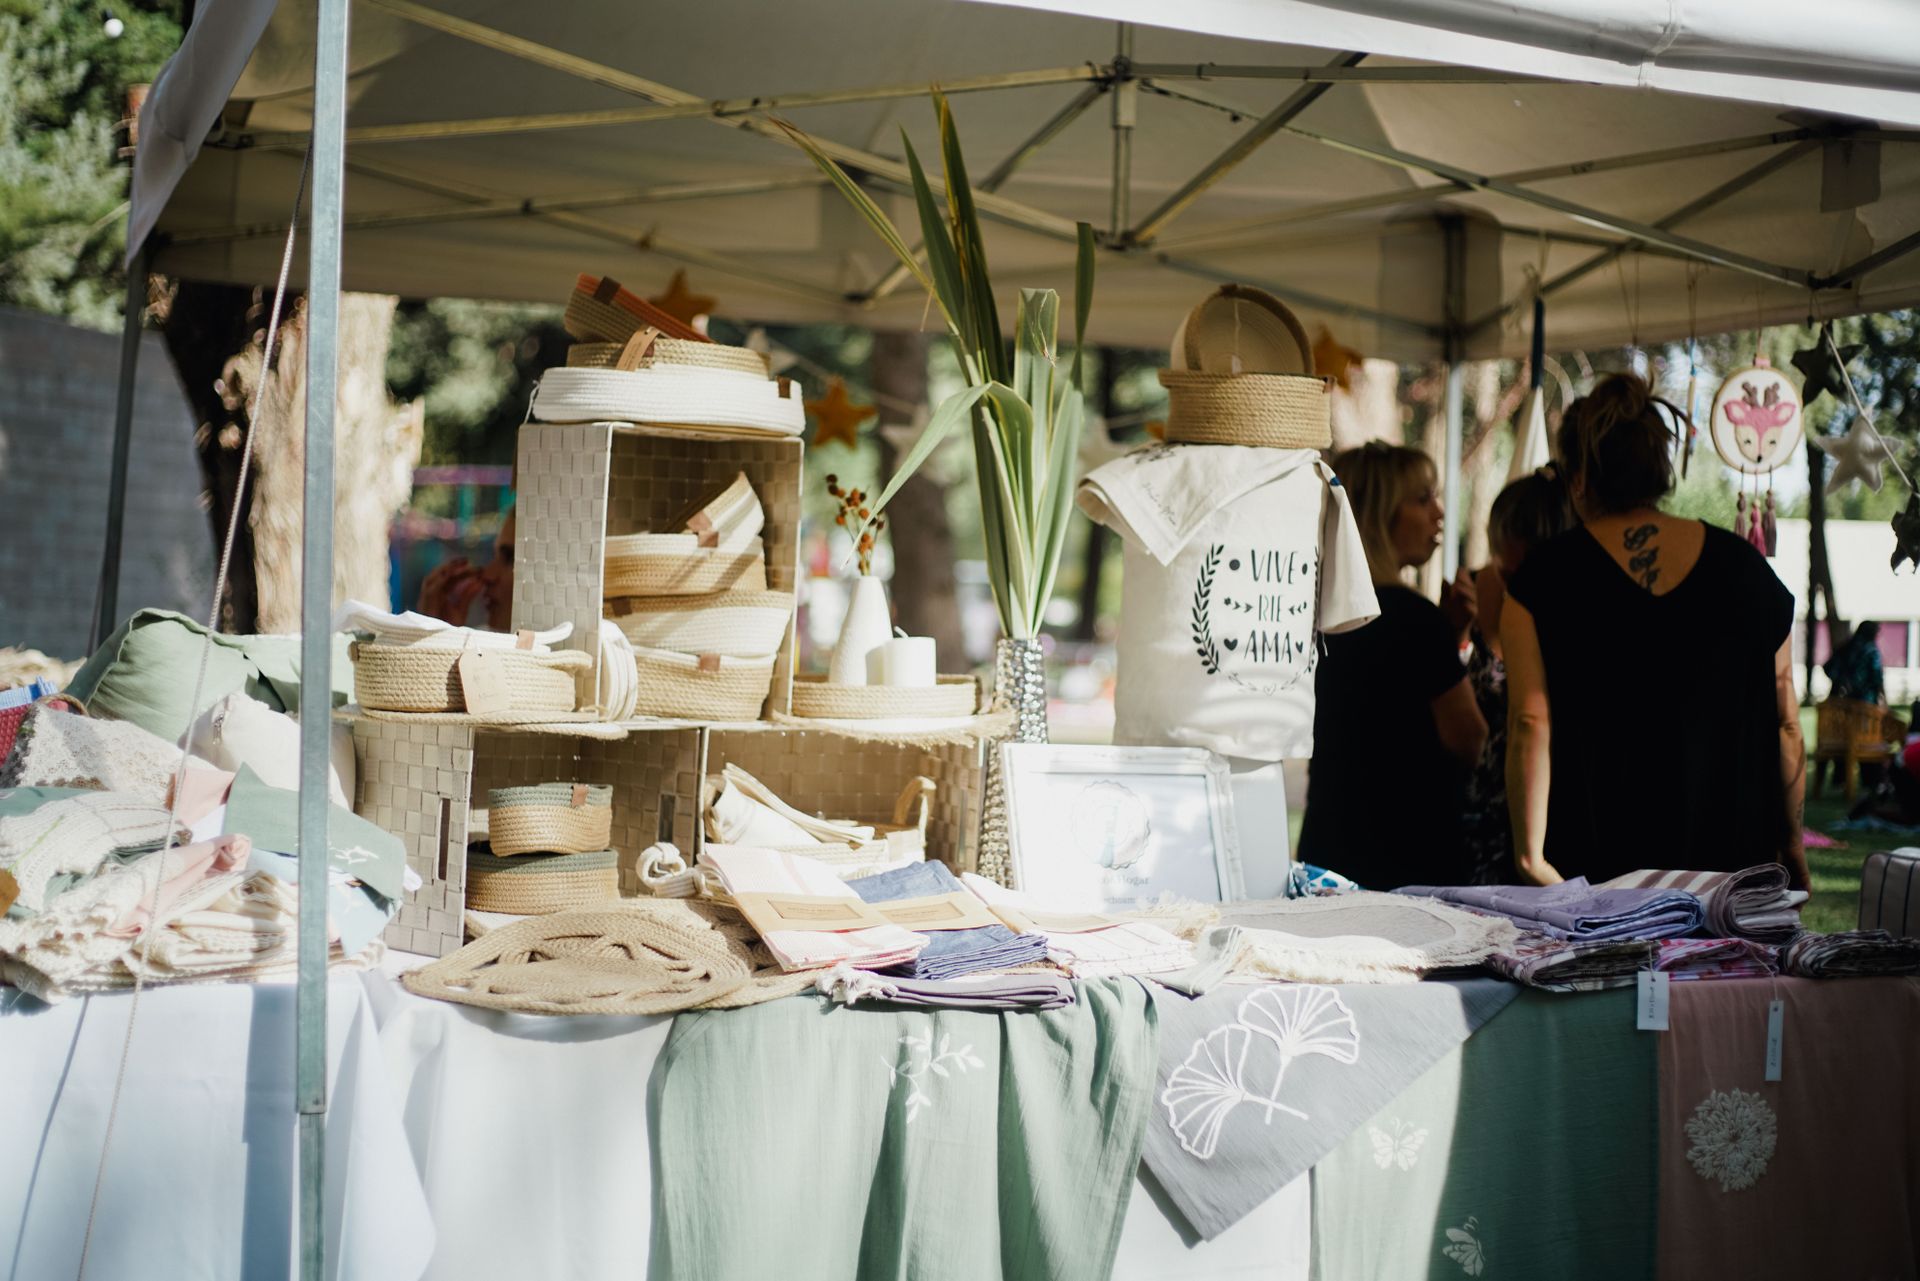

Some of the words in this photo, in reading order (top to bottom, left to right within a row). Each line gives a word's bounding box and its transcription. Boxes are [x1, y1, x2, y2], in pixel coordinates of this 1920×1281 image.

[1251, 549, 1298, 584] VIVE
[1258, 594, 1283, 622] RIE
[1244, 629, 1293, 664] AMA
